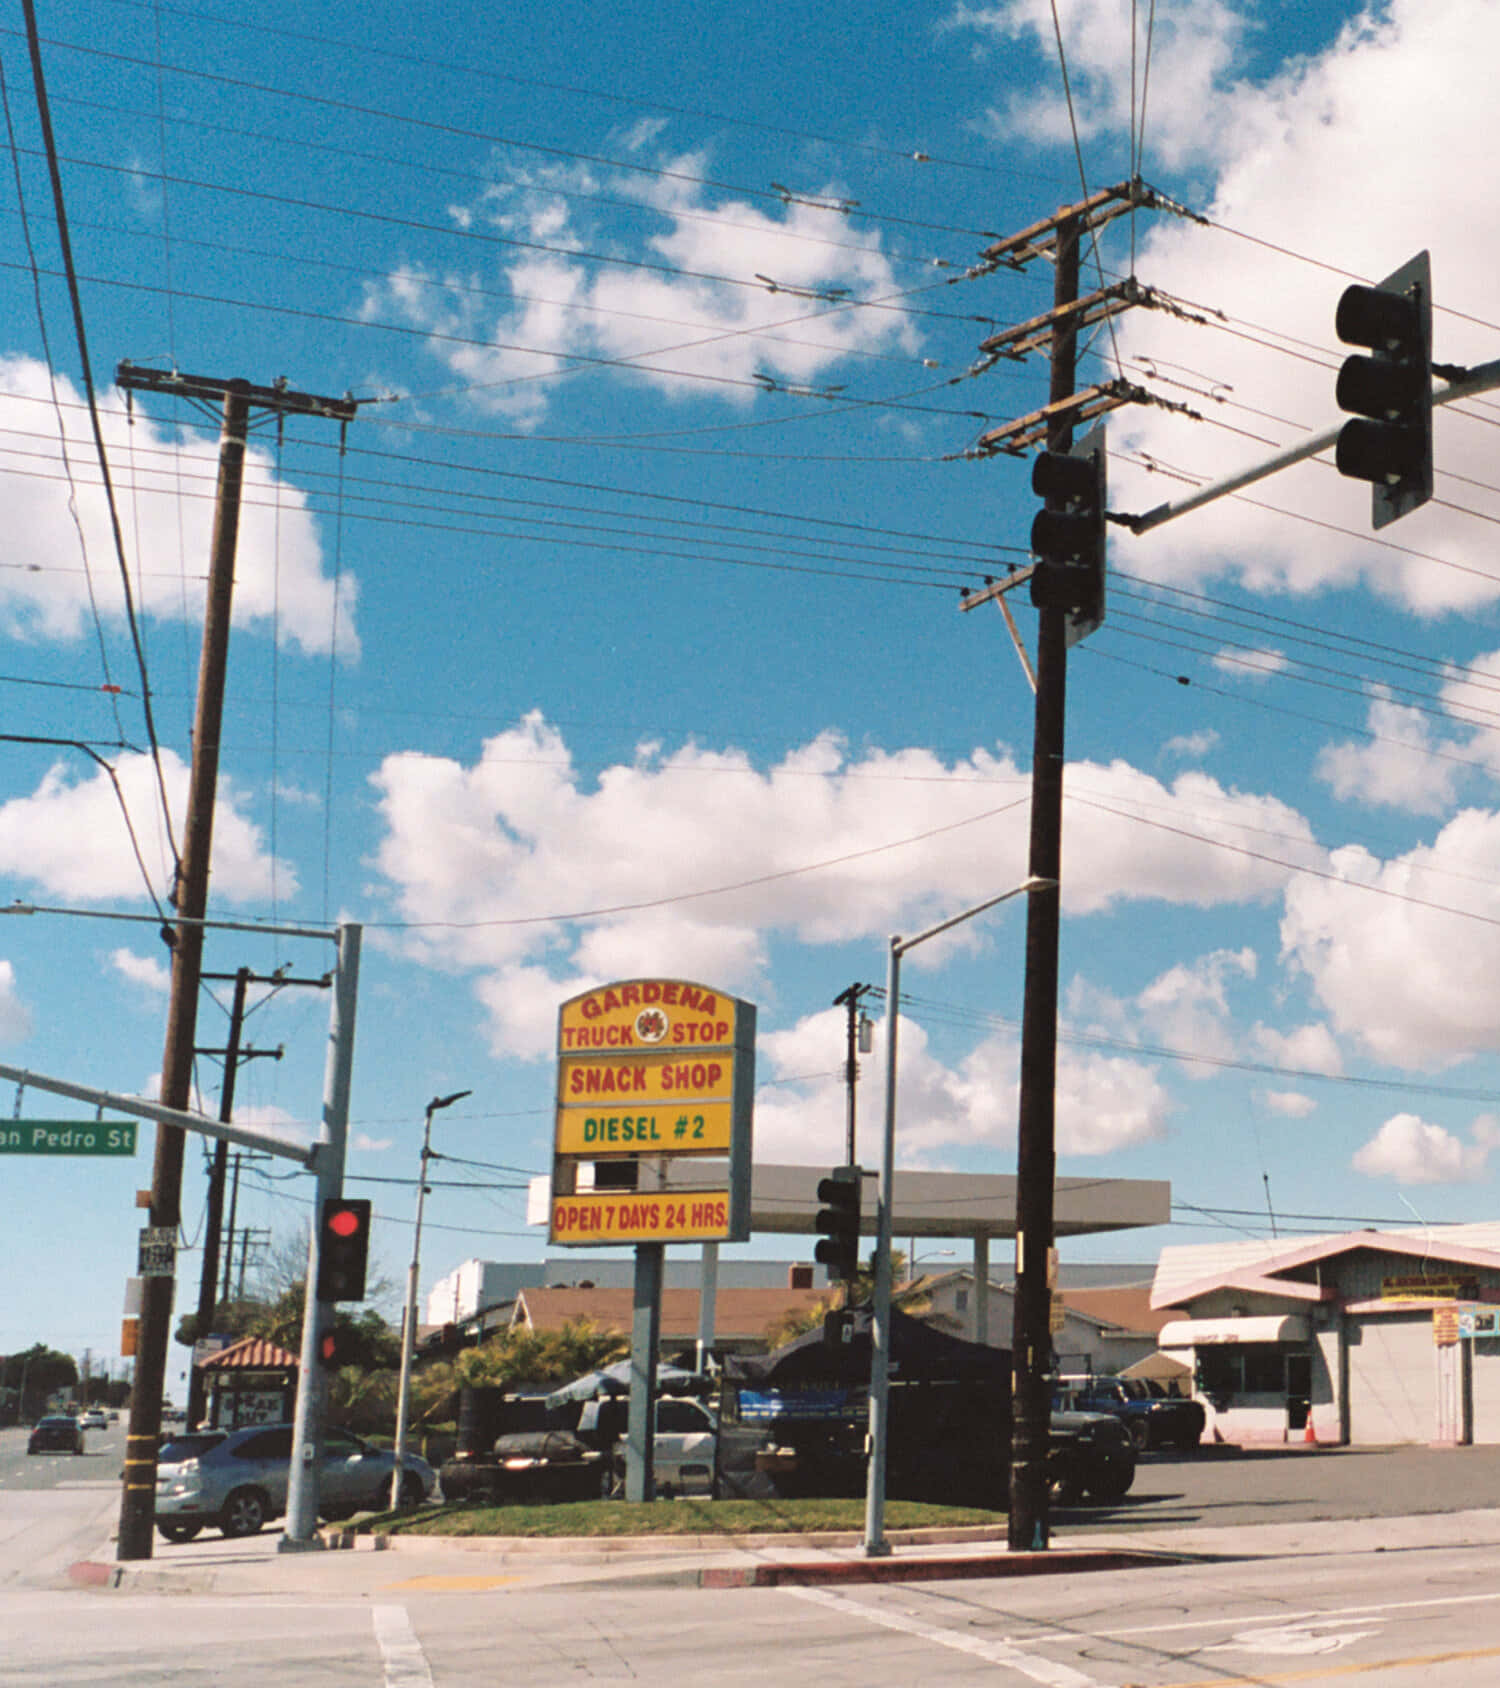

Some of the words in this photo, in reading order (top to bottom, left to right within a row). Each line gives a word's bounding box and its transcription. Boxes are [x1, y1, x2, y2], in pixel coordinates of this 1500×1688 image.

[580, 982, 717, 1020] GARDENA
[563, 1025, 633, 1048] TRUCK
[672, 1022, 729, 1045] STOP
[570, 1066, 646, 1095] SNACK
[661, 1064, 722, 1090] SHOP
[32, 1128, 96, 1148] Pedro
[107, 1128, 131, 1148] St
[583, 1117, 661, 1143] DIESEL
[555, 1206, 602, 1231] OPEN
[604, 1205, 616, 1230] 7
[618, 1203, 660, 1230] DAYS
[665, 1202, 687, 1229] 24
[691, 1201, 728, 1228] HRS.
